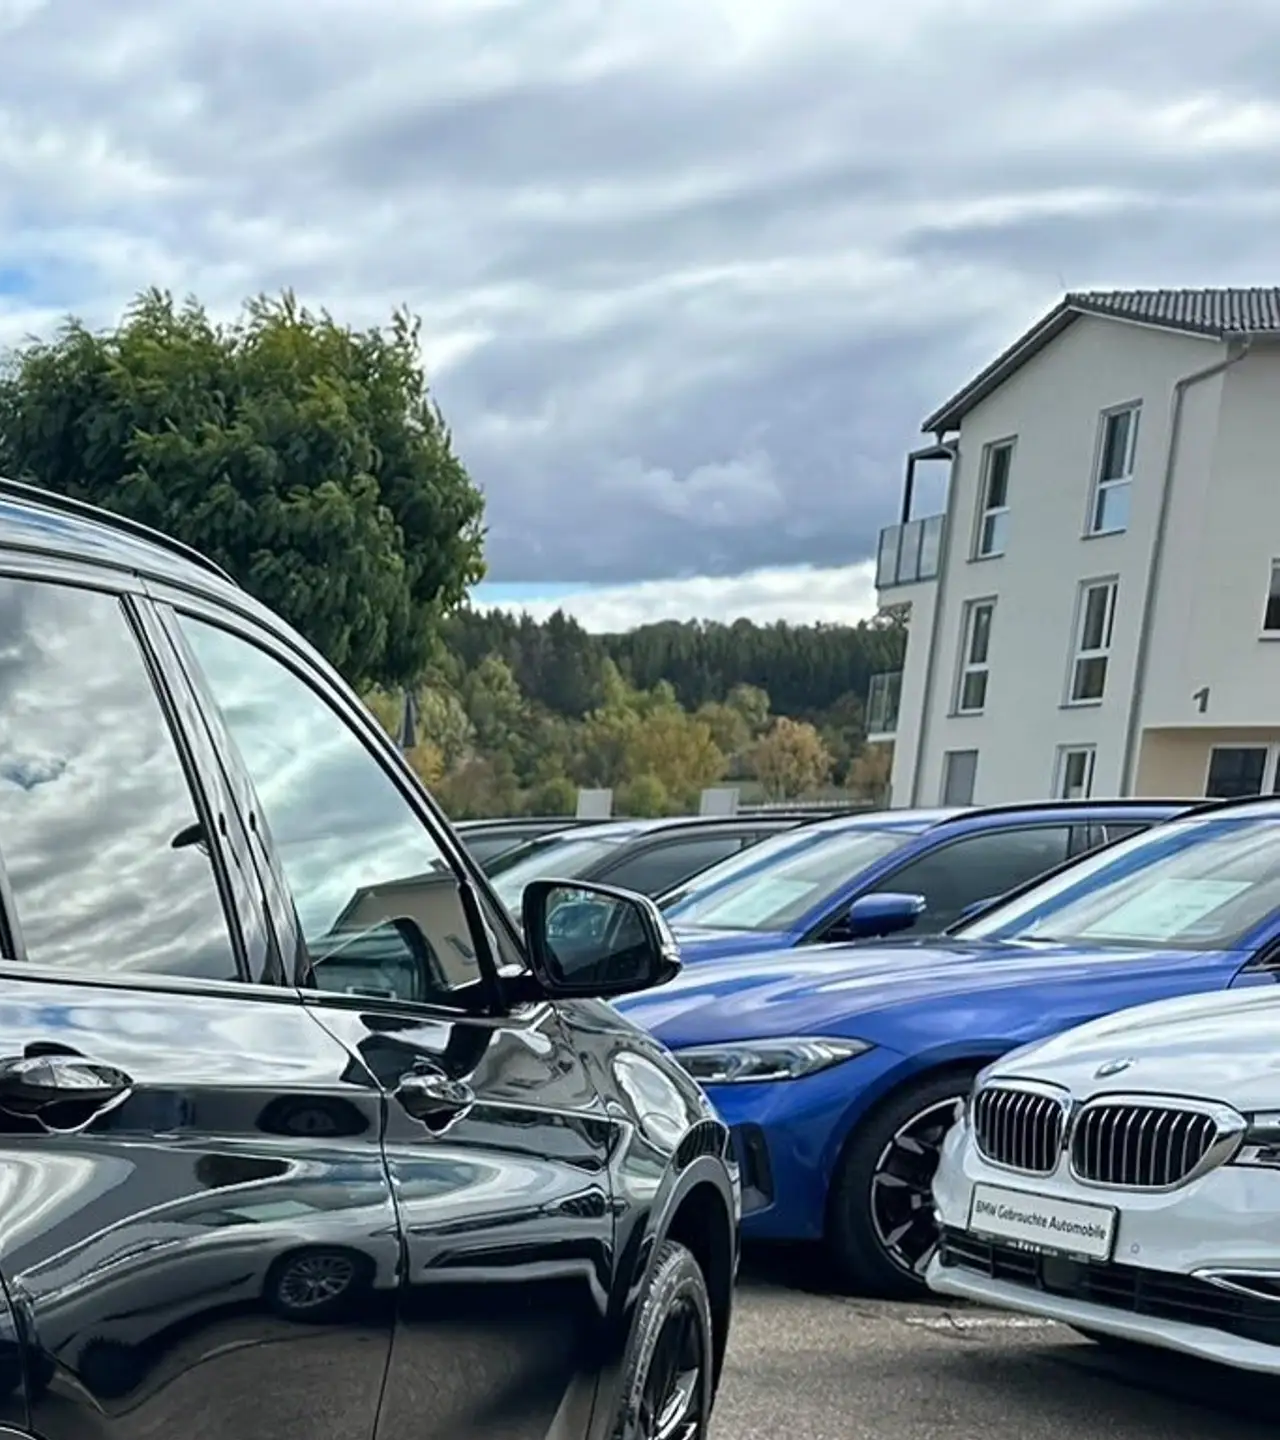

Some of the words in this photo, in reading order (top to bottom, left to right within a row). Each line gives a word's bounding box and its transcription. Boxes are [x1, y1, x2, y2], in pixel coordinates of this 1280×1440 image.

[1192, 686, 1210, 714] 1
[976, 1200, 996, 1215] BMW
[999, 1204, 1048, 1228] Gebrauchte
[1049, 1216, 1107, 1239] Automobile
